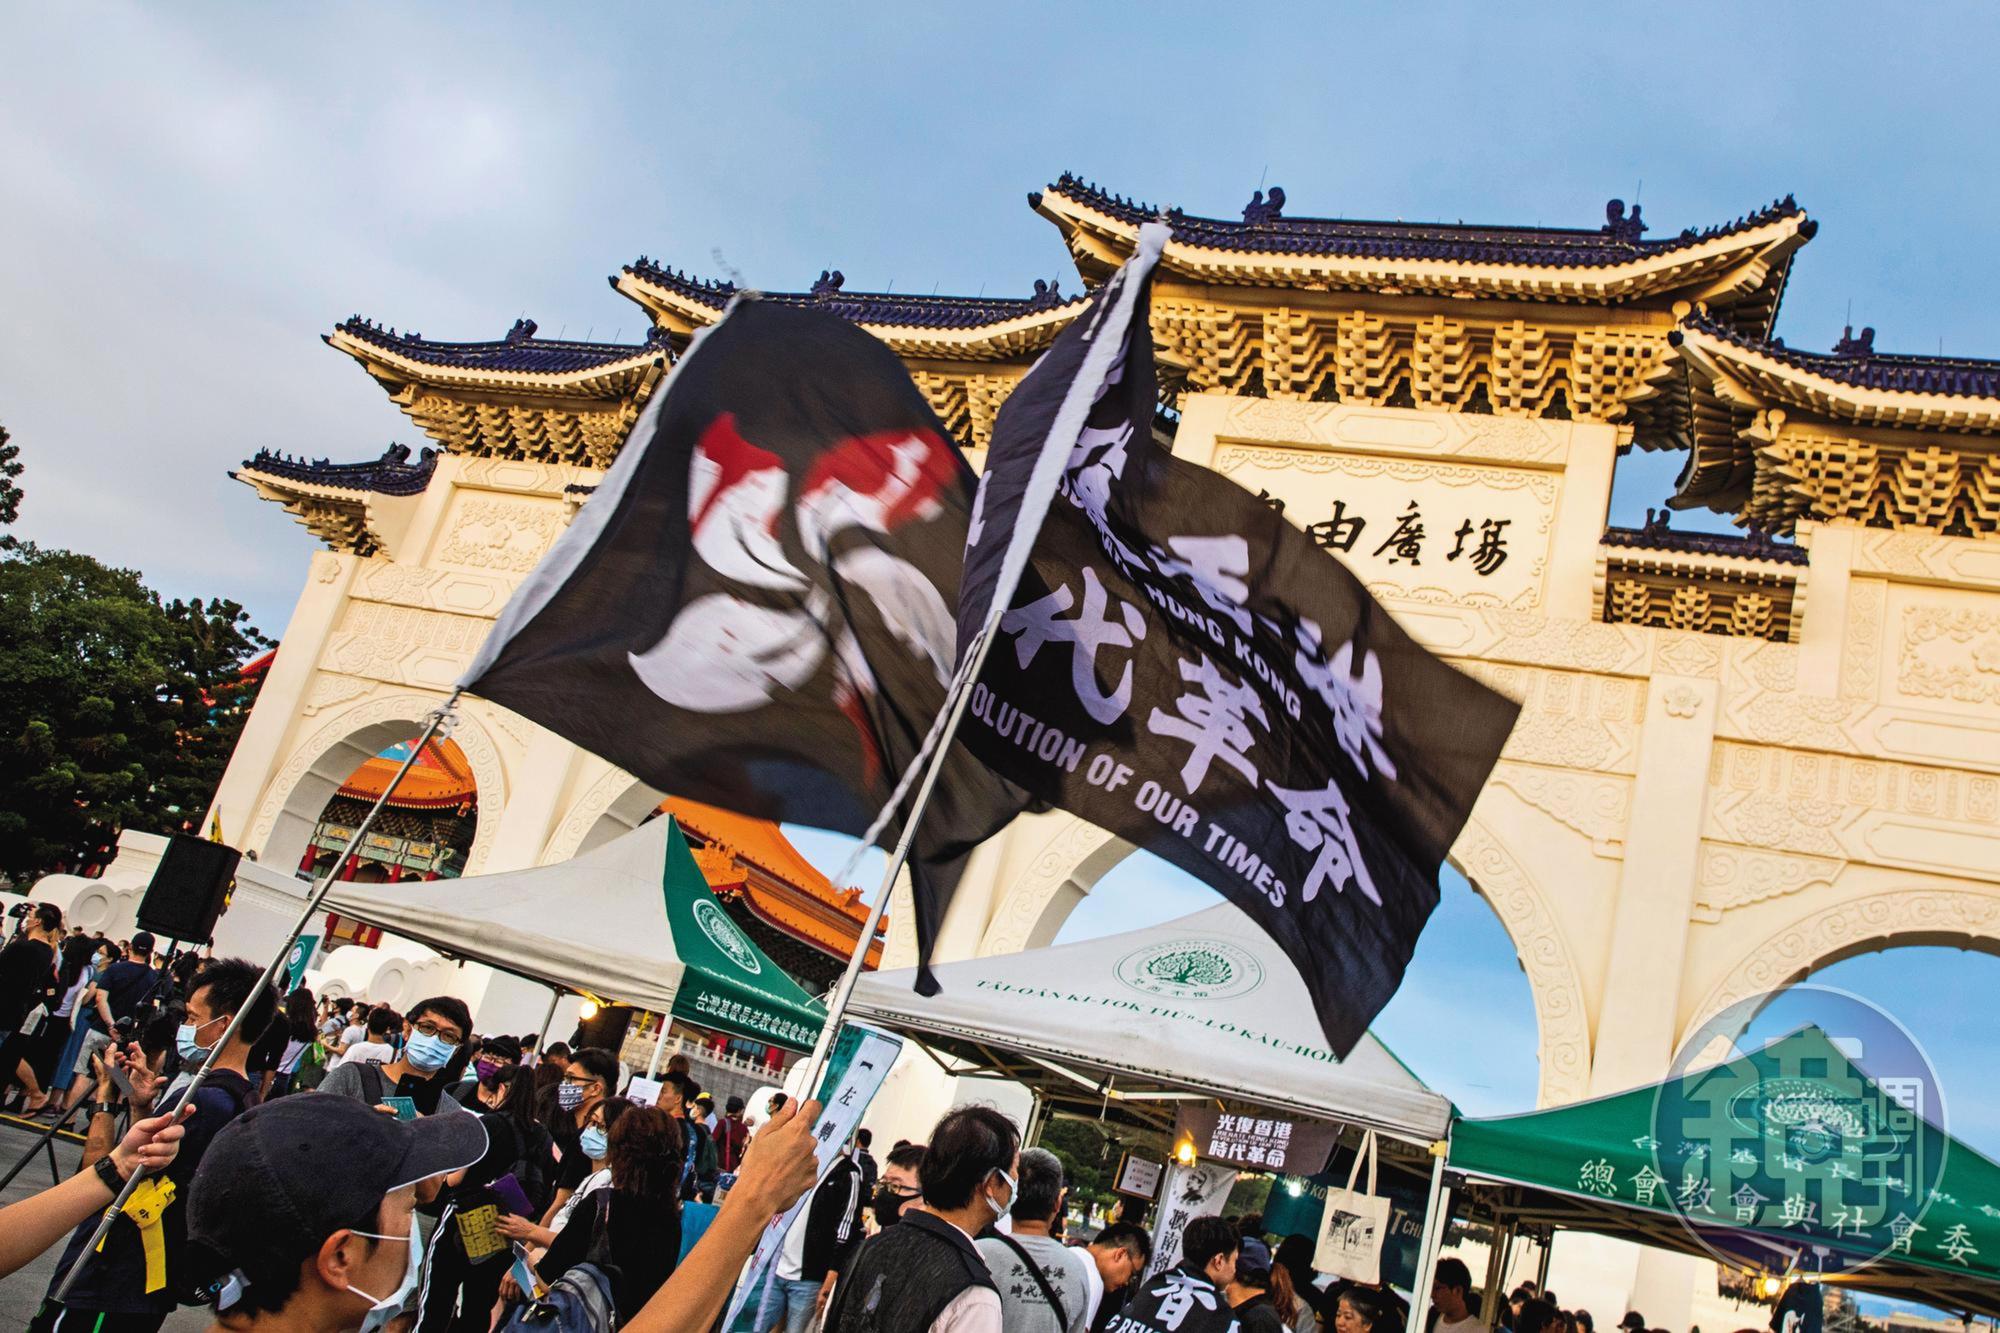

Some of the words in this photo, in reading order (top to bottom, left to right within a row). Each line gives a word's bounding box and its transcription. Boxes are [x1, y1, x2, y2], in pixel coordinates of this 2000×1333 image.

[1144, 583, 1225, 647] HONG
[1235, 636, 1301, 721] KONG
[970, 683, 1087, 773] OLUTION
[1086, 754, 1134, 792] OF
[1134, 780, 1200, 838] OUR
[1204, 822, 1286, 908] TIMES
[1208, 1140, 1286, 1168] 時代革命
[1216, 1114, 1293, 1139] 光復香港
